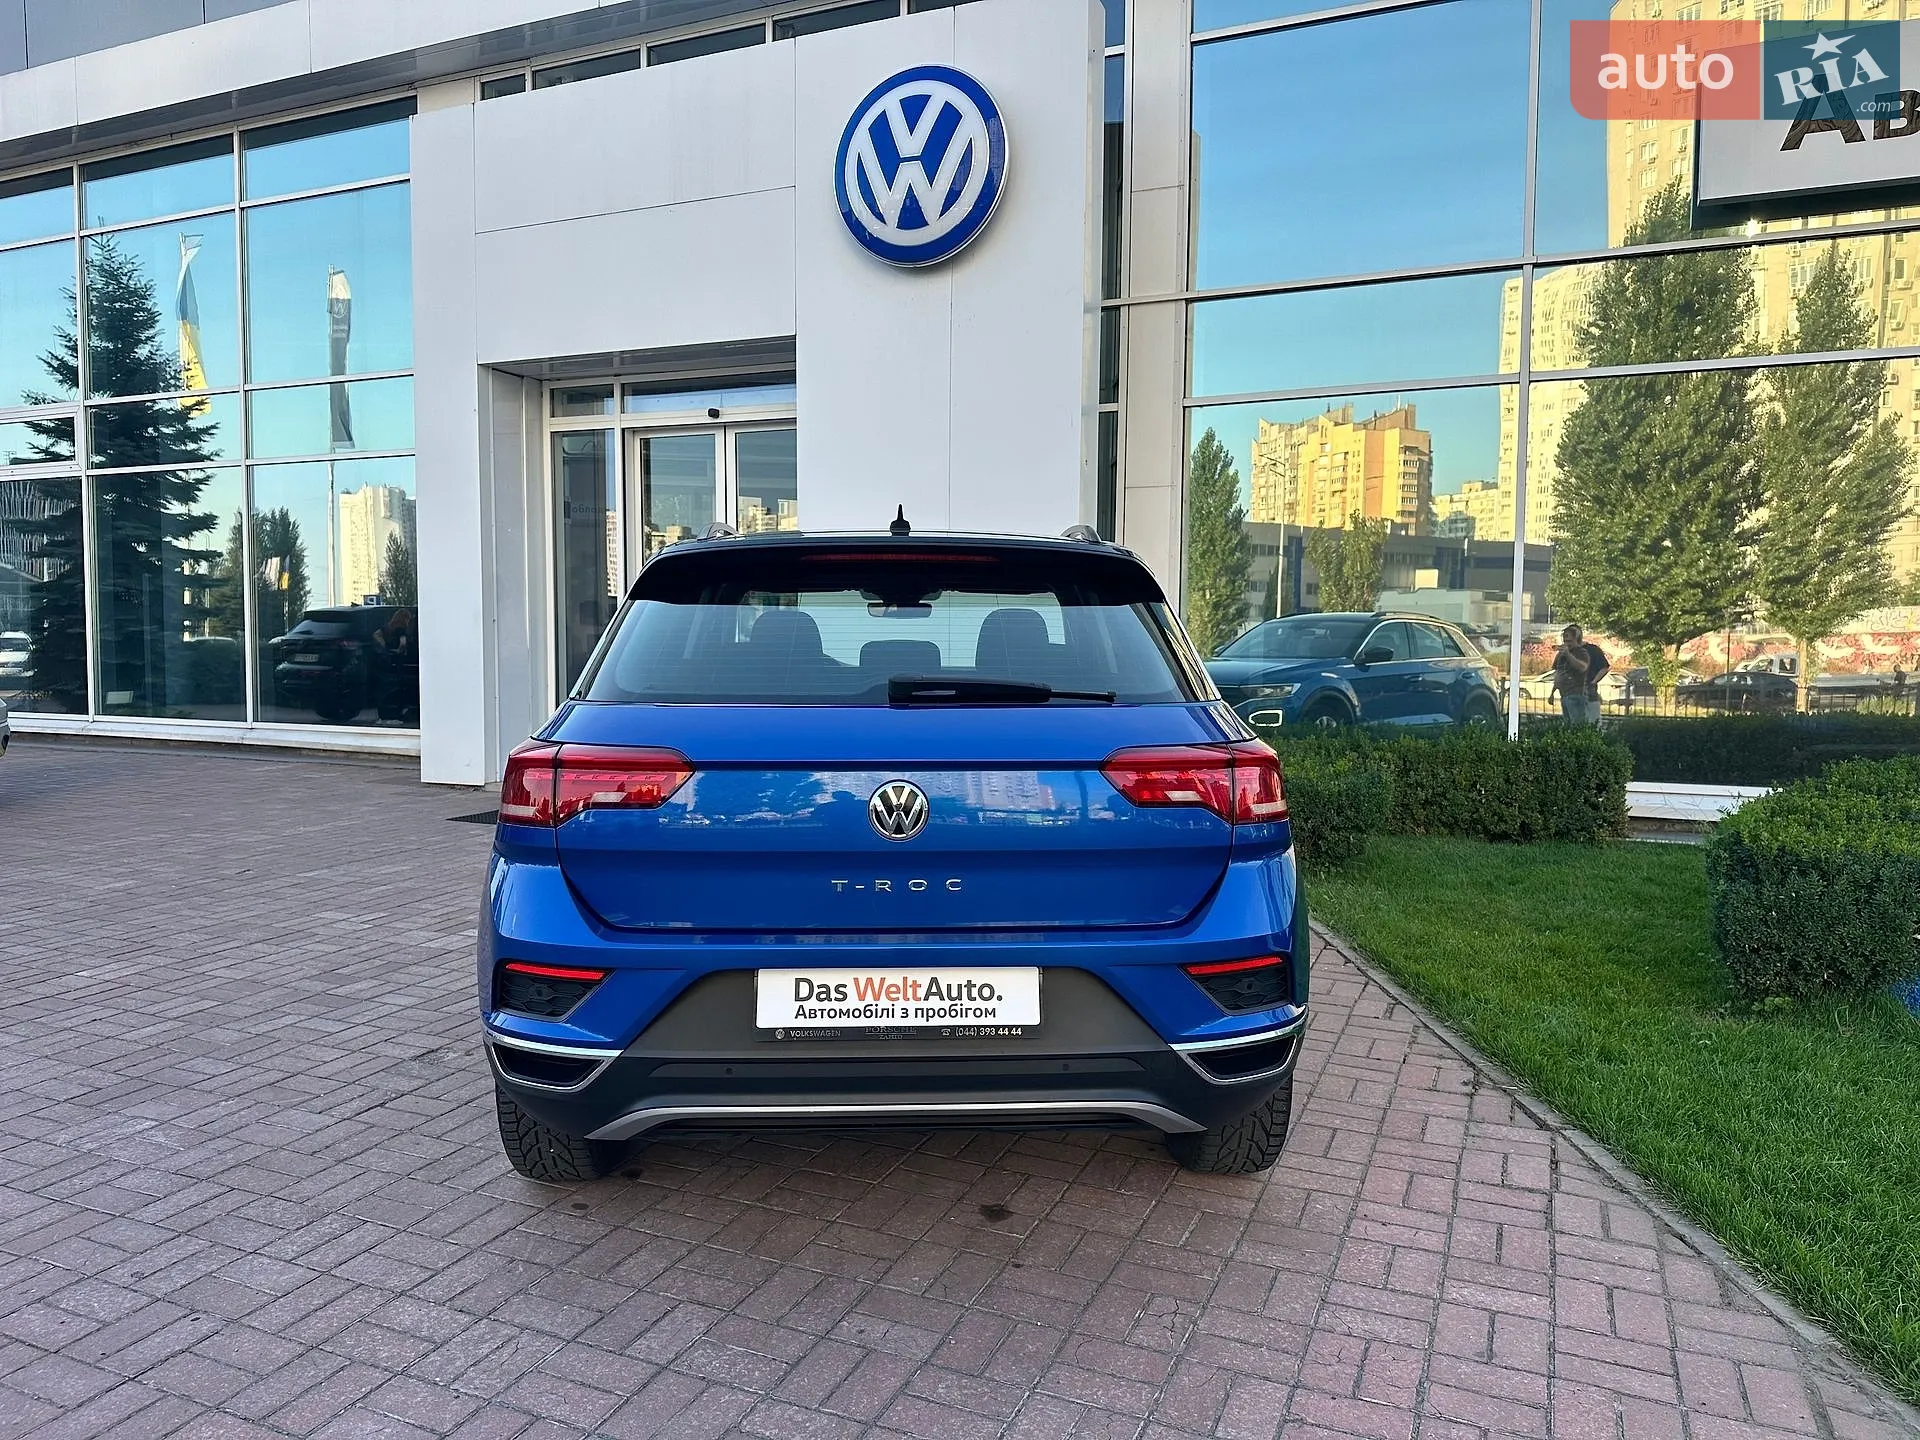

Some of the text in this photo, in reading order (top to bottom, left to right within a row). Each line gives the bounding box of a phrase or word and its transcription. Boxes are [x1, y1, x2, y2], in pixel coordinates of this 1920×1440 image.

[794, 977, 848, 1002] Das
[794, 1003, 996, 1022] Автомобілі з пробігом
[955, 1026, 1023, 1037] (044) 393 44 44
